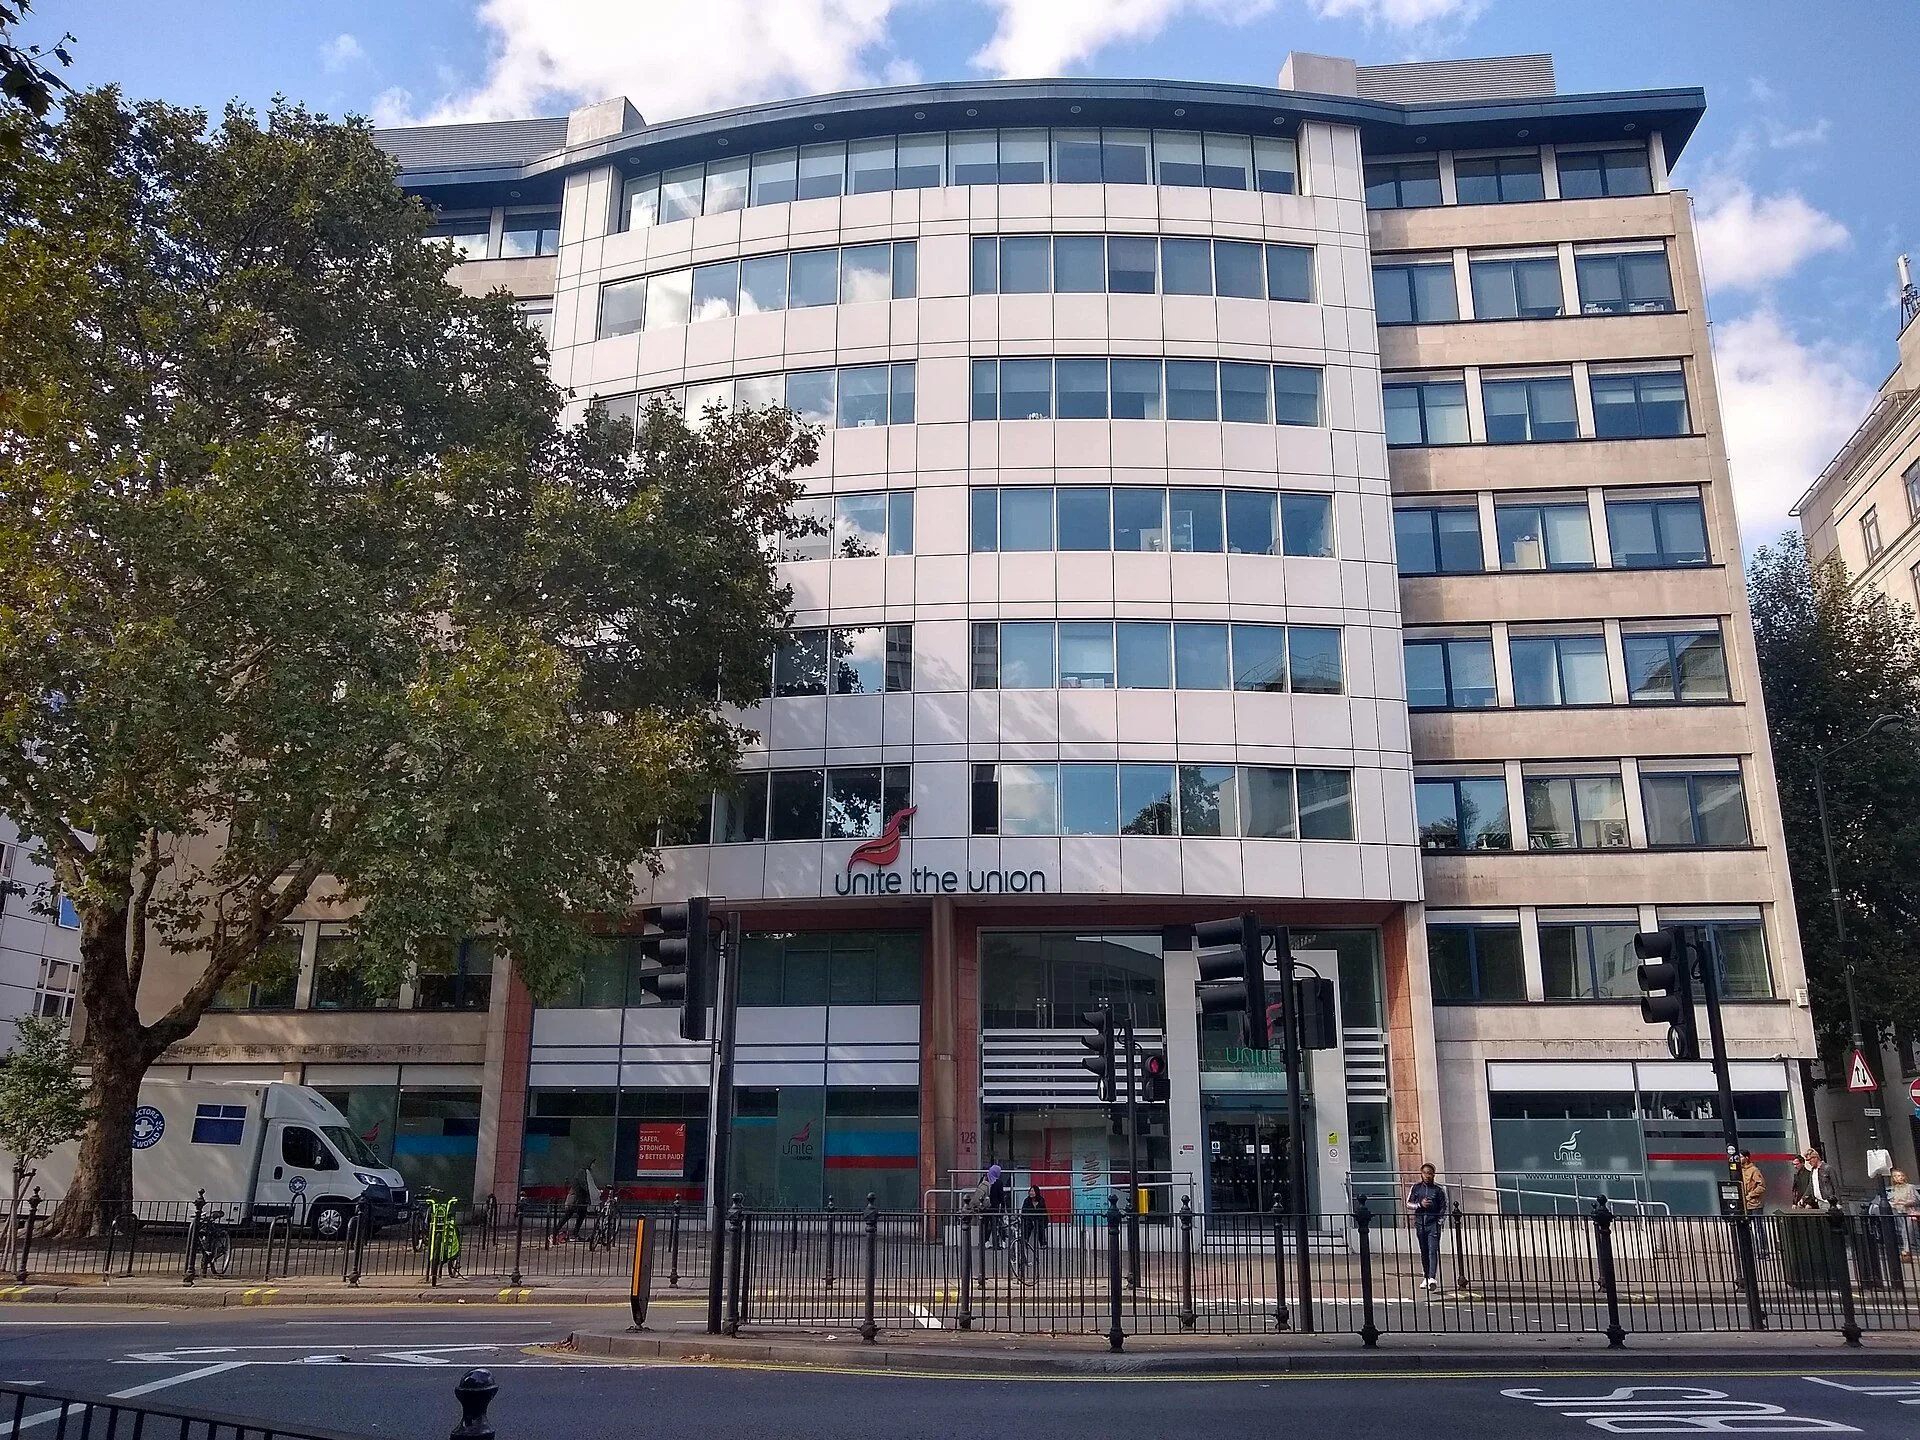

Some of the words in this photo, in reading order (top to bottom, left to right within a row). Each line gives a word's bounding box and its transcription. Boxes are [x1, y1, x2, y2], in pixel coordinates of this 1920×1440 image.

[835, 870, 902, 895] unite
[912, 865, 958, 893] the
[968, 870, 1045, 893] union
[135, 1108, 160, 1119] CTORS
[136, 1132, 160, 1148] WORLD
[960, 1131, 977, 1144] 128
[1400, 1131, 1419, 1146] 128
[782, 1142, 813, 1155] unite
[1553, 1149, 1582, 1161] unite
[1500, 1386, 1864, 1433] BUS
